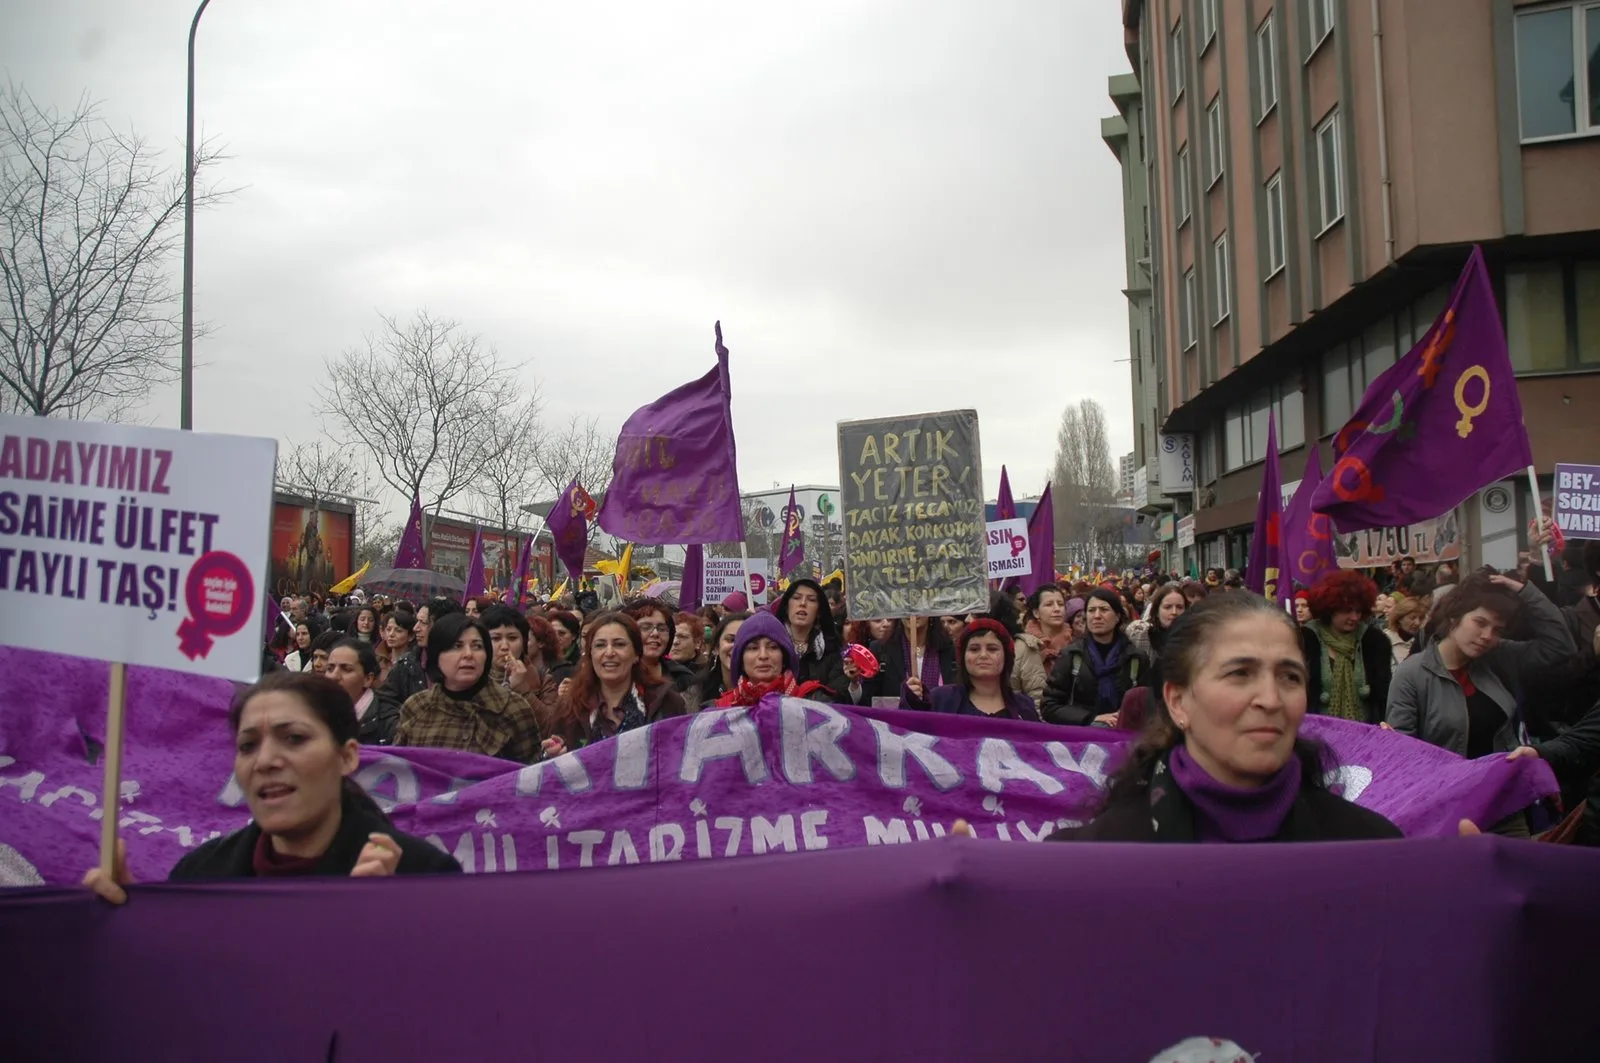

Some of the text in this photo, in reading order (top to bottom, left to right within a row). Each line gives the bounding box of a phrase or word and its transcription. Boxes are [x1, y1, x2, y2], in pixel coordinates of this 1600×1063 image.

[0, 434, 174, 495] ADAYIMIZ
[859, 428, 959, 466] ARTIK
[115, 496, 220, 557] ÜLFET
[1364, 526, 1429, 556] 1750 TL
[0, 547, 180, 620] TAYLI TAŞ!
